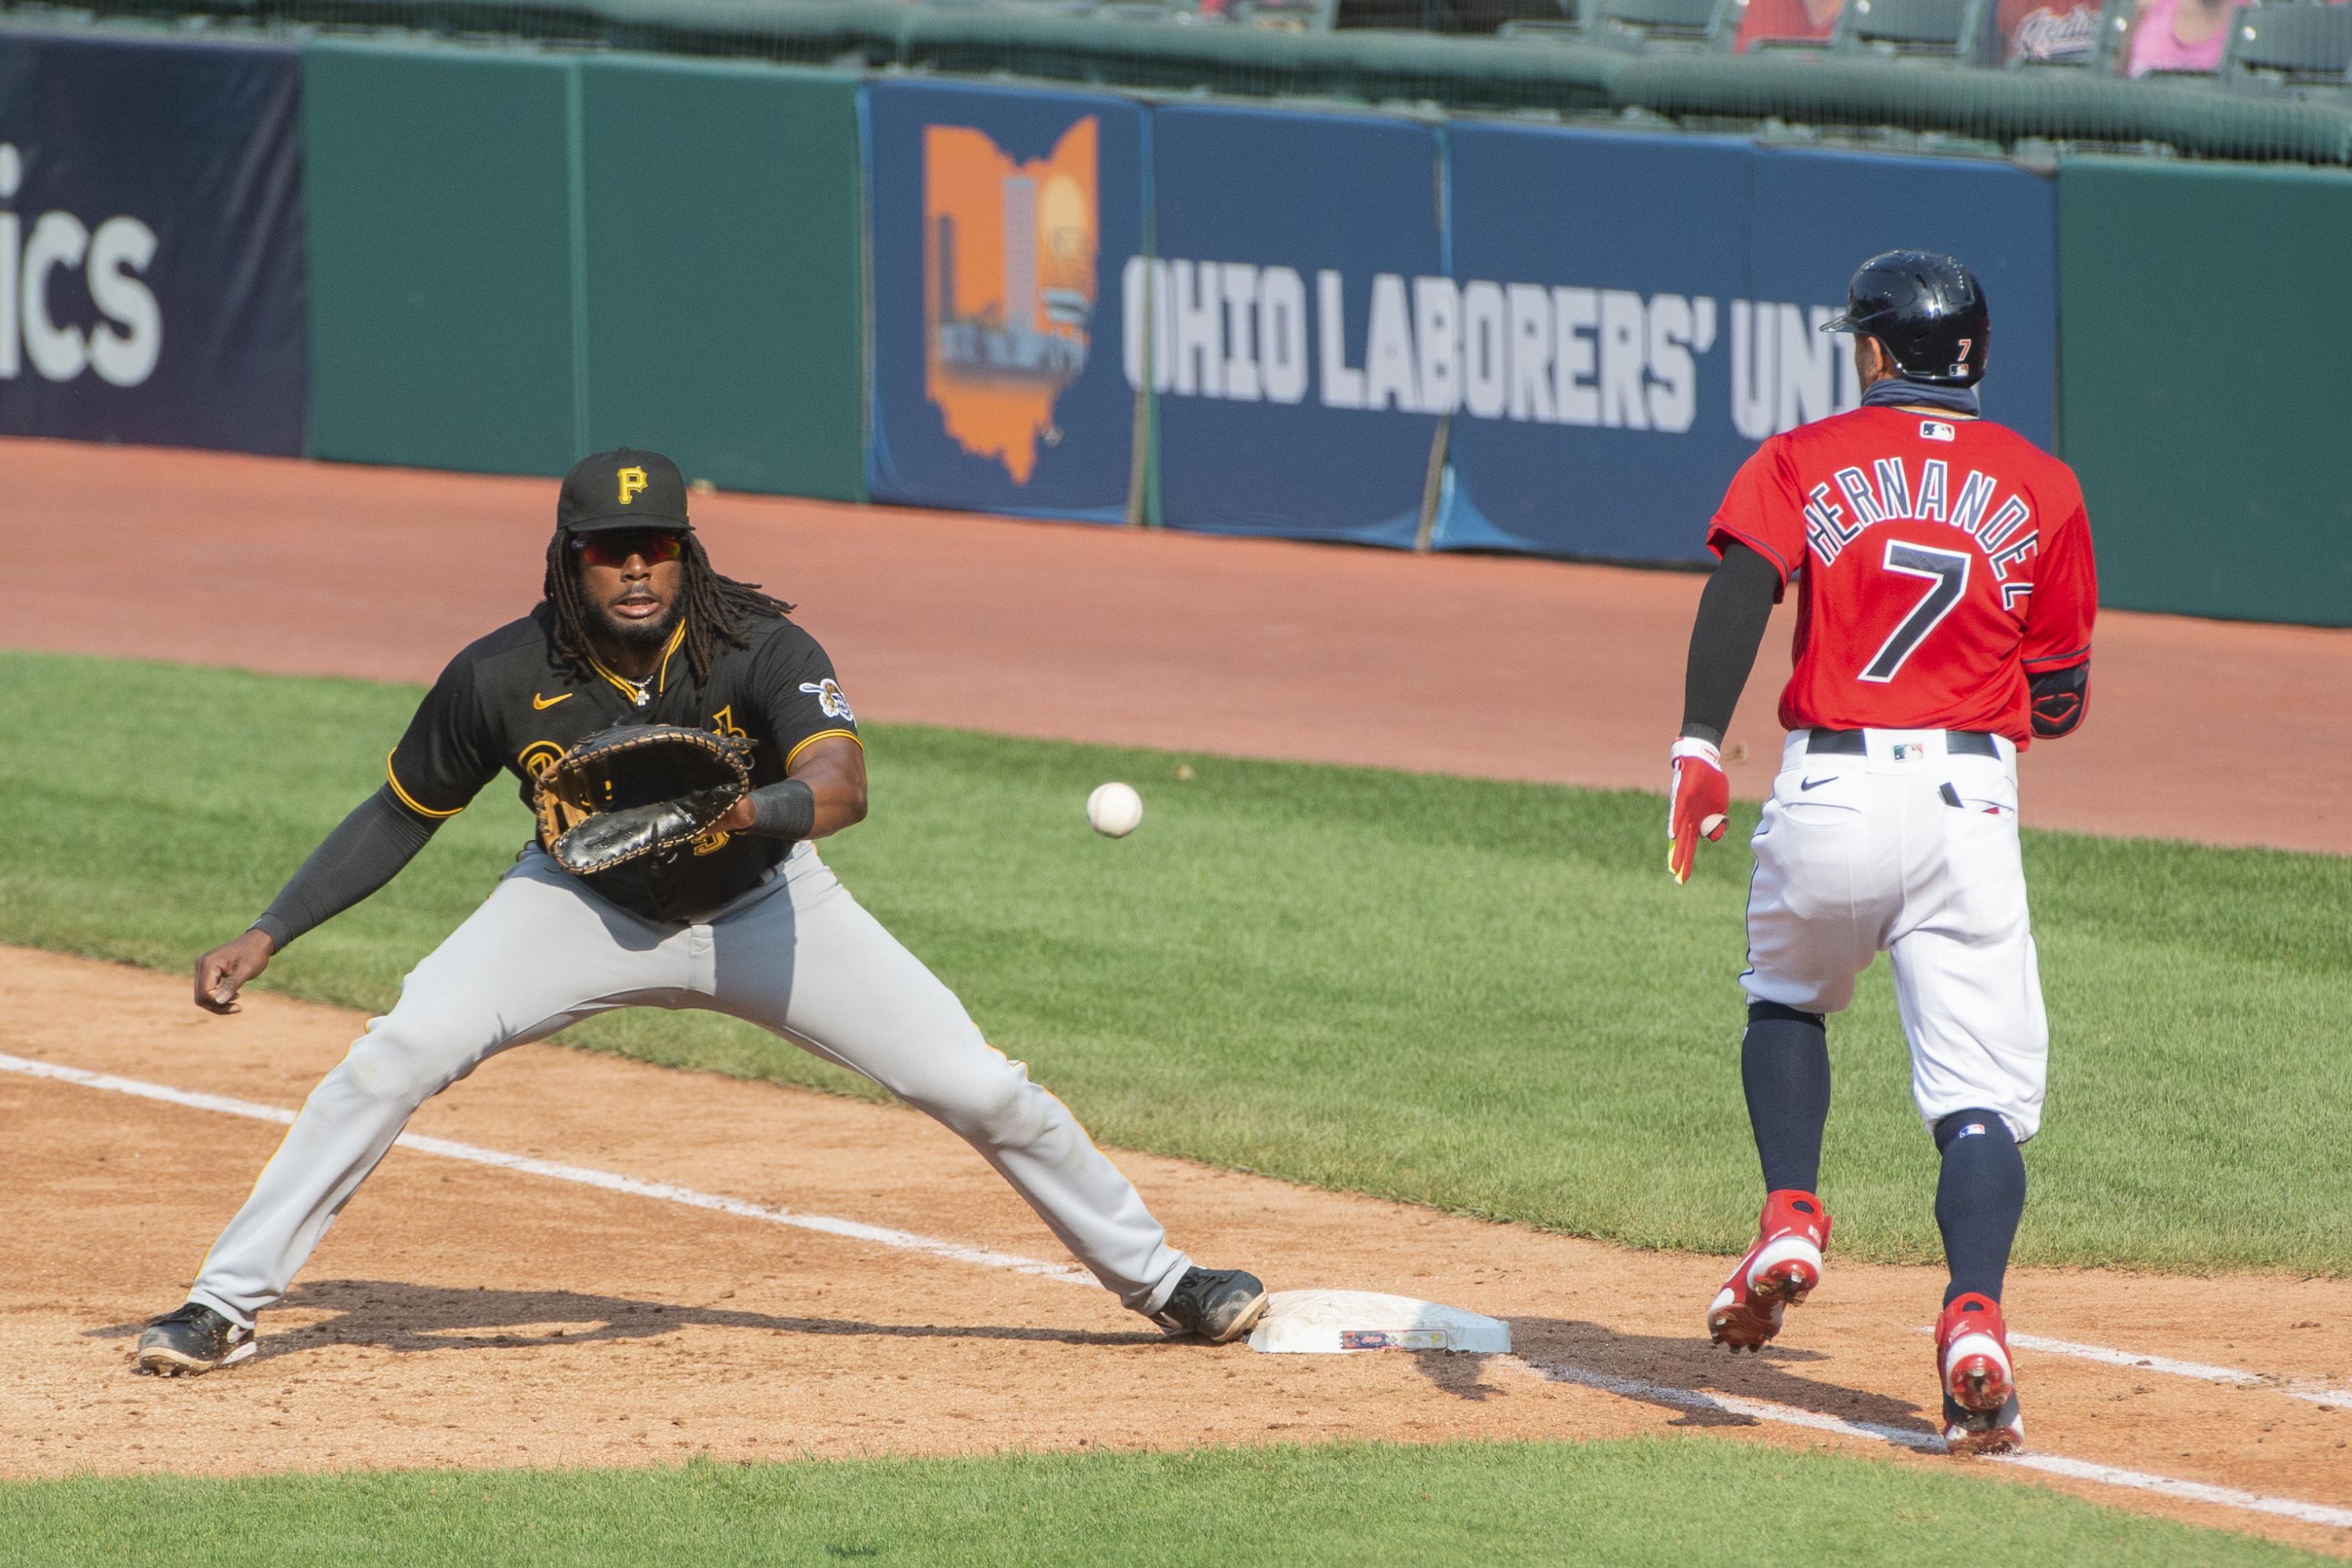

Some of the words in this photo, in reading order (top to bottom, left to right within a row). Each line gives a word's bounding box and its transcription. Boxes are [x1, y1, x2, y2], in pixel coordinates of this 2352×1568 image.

[1121, 255, 1309, 405] OHIO
[1316, 269, 1717, 434] LABORERS'
[1729, 297, 1864, 441] UNI
[1957, 338, 1972, 362] 7
[616, 465, 649, 505] P
[1856, 537, 1973, 684] 7
